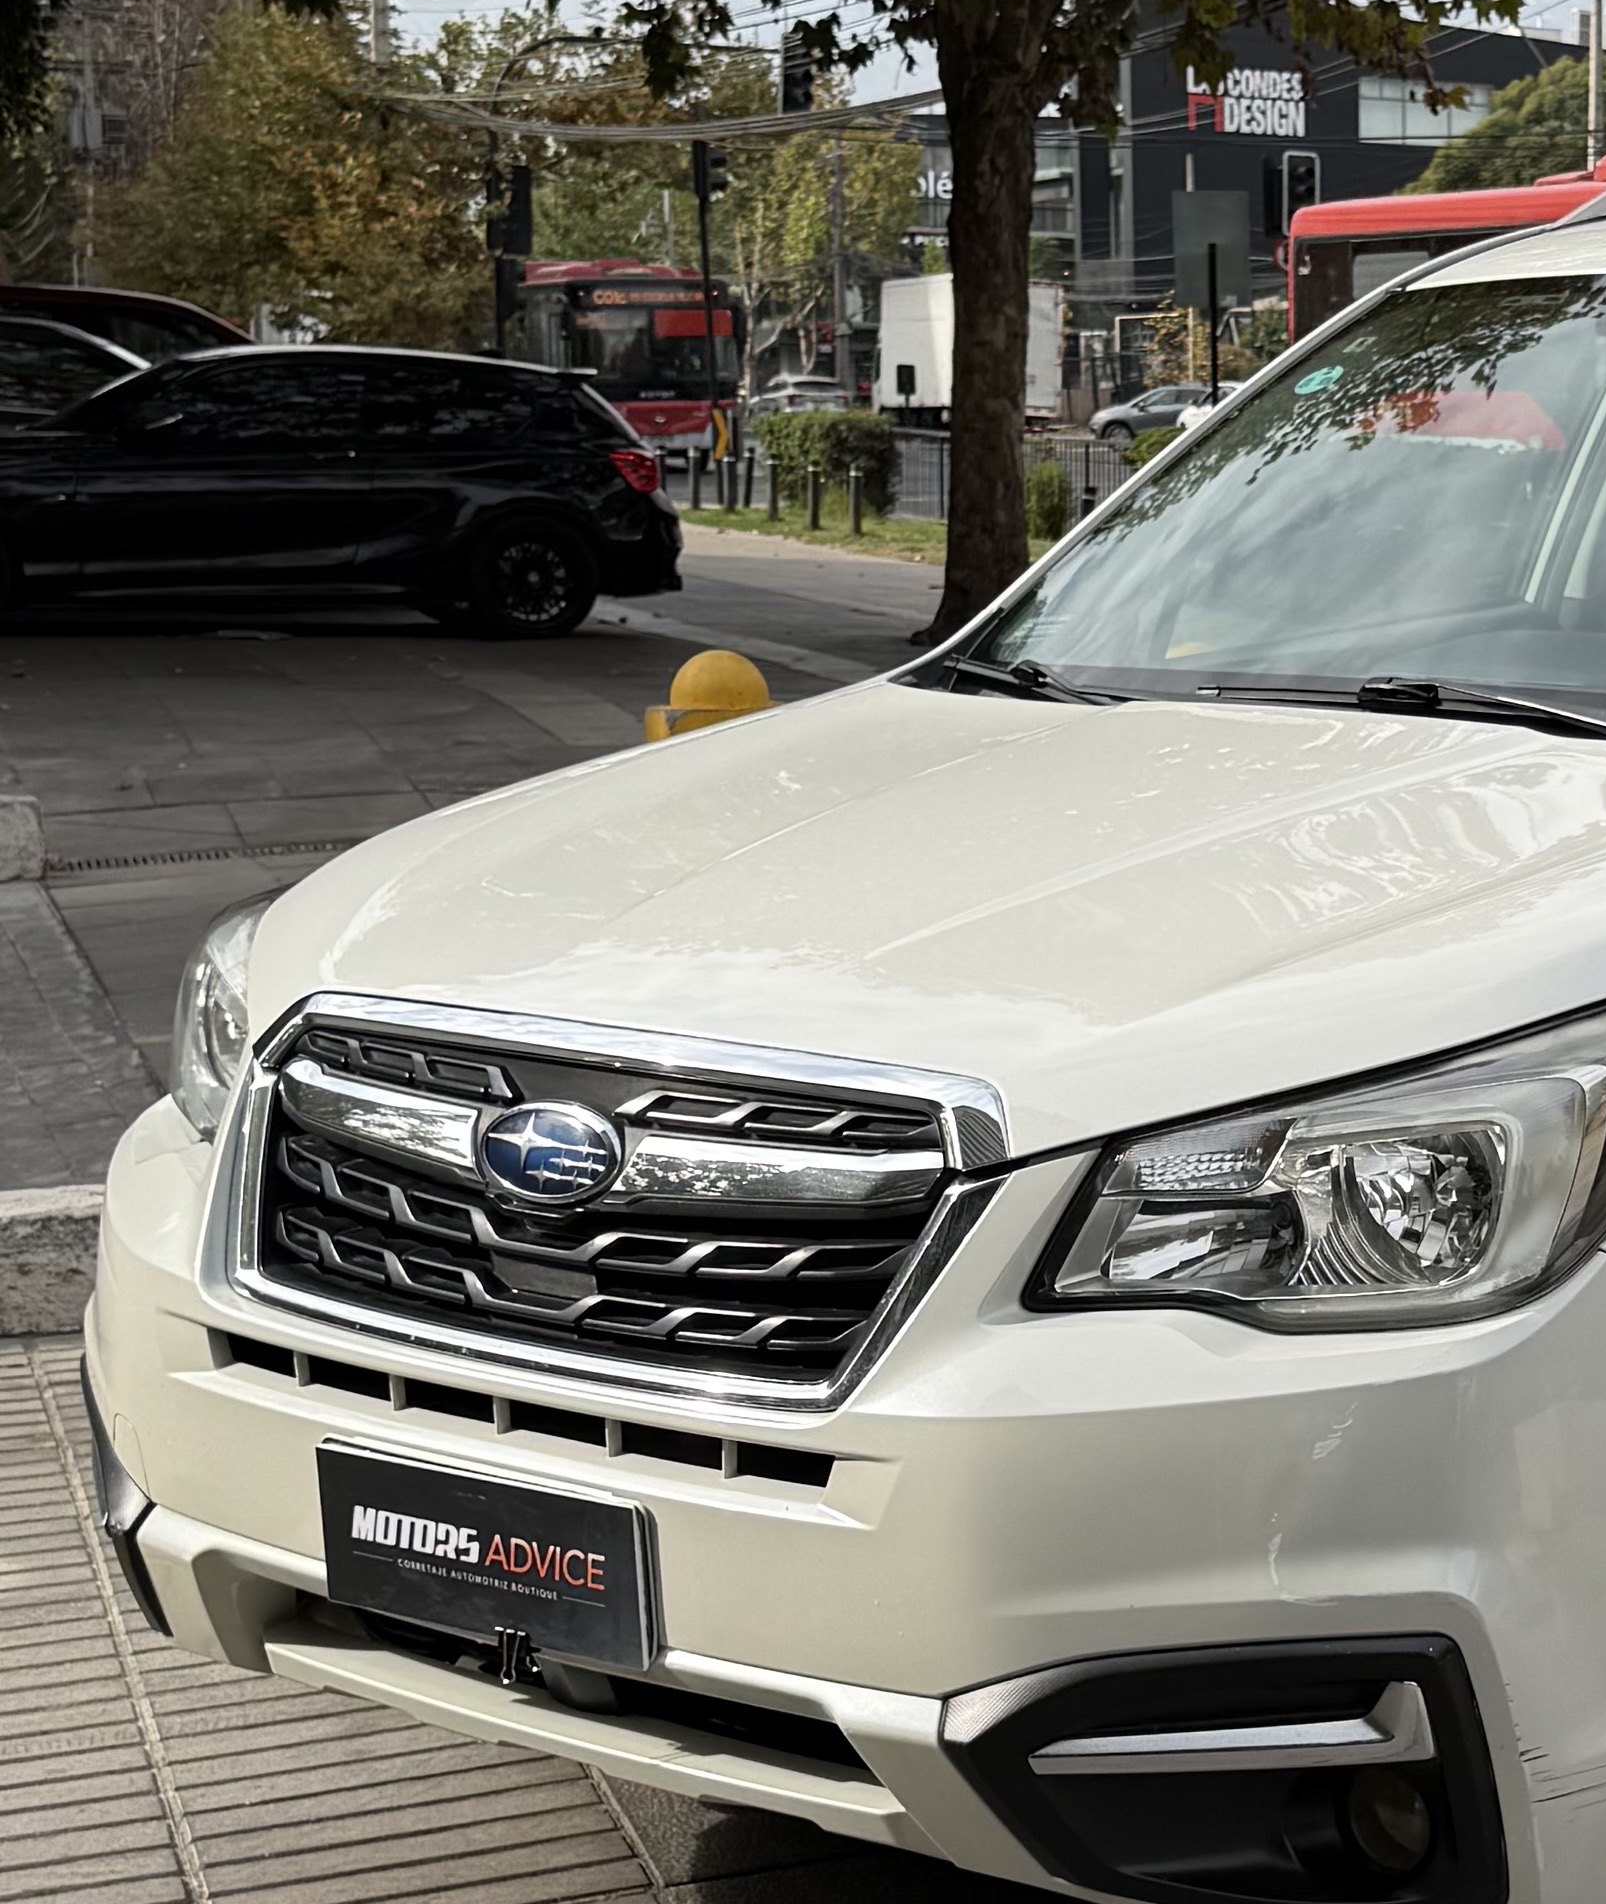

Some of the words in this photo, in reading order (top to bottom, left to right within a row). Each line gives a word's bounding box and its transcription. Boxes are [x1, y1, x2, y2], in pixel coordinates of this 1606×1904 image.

[1226, 66, 1304, 100] CONDES
[1224, 96, 1306, 137] DESIGN
[351, 1505, 480, 1564] MOTORS
[484, 1534, 605, 1590] ADVICE
[397, 1558, 447, 1577] CORRETAJE
[450, 1571, 509, 1590] AUTOMOTRIZ
[511, 1582, 558, 1601] BOUTIQUE
